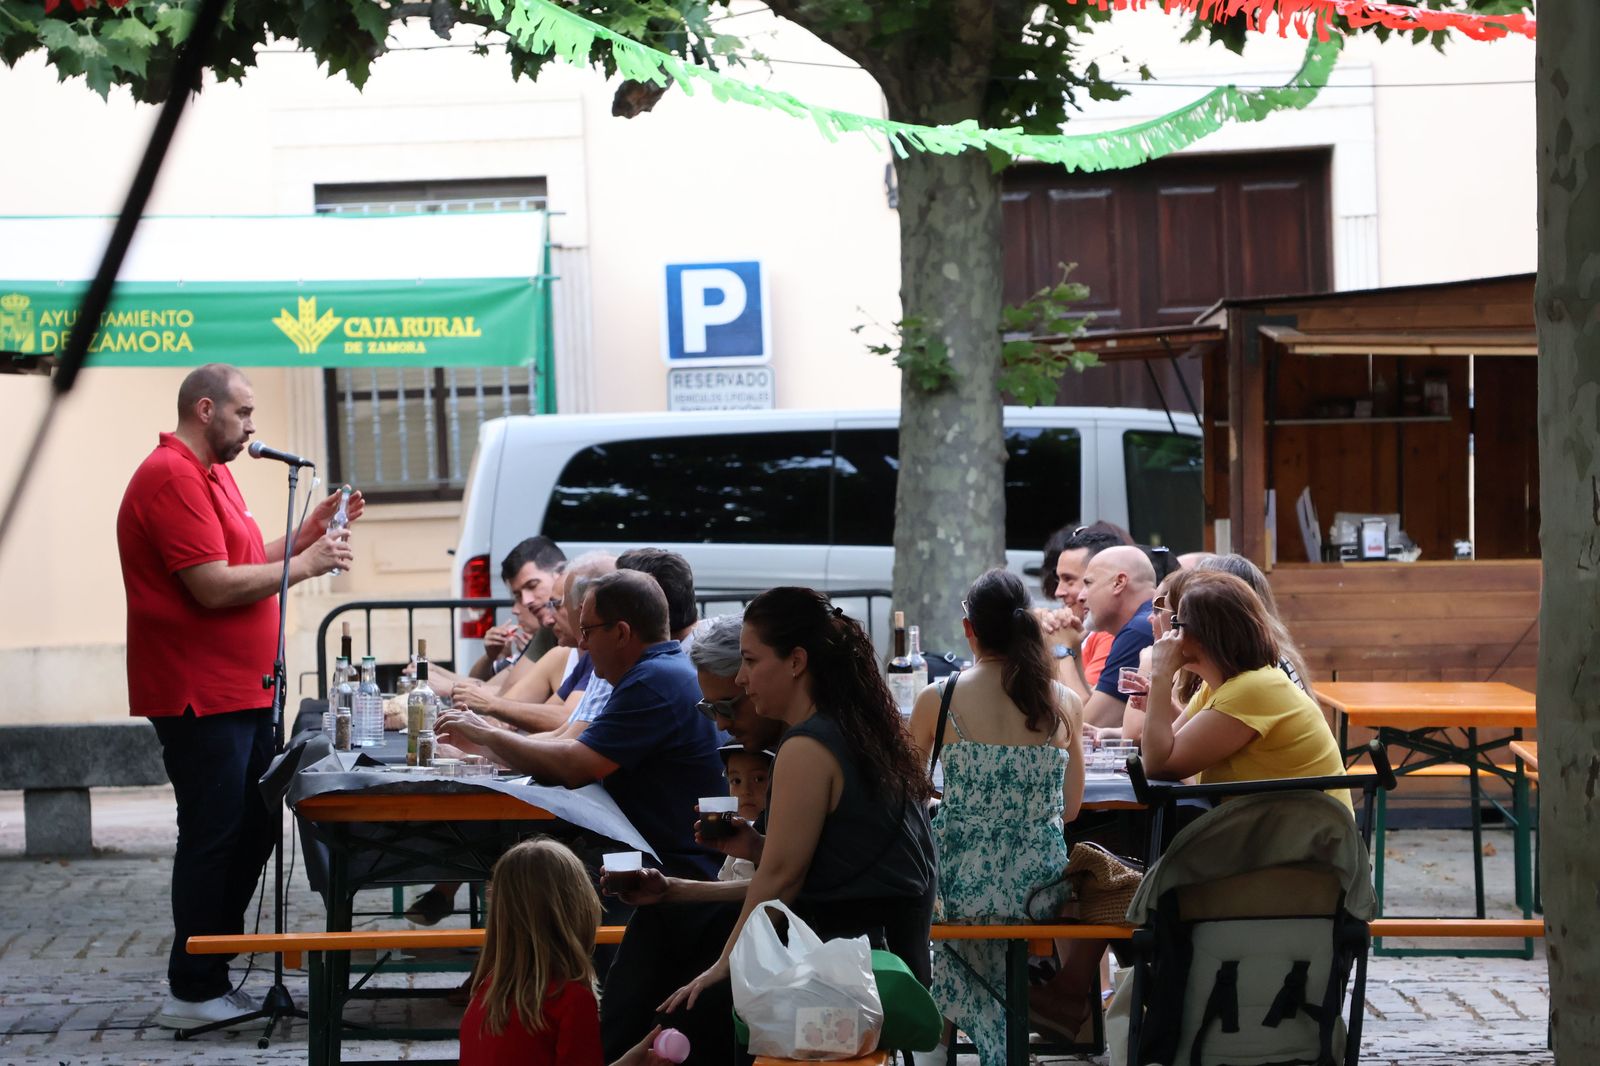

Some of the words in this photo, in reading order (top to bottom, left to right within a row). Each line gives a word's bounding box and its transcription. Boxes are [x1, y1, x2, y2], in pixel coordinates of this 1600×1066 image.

[39, 309, 195, 327] AYUTAMIENTO
[680, 268, 748, 353] P
[343, 316, 400, 339] CAJA
[400, 316, 482, 338] RURAL
[87, 330, 194, 353] ZAMORA
[344, 341, 363, 354] DE
[367, 341, 427, 354] ZAMORA
[673, 371, 769, 388] RESERVADO
